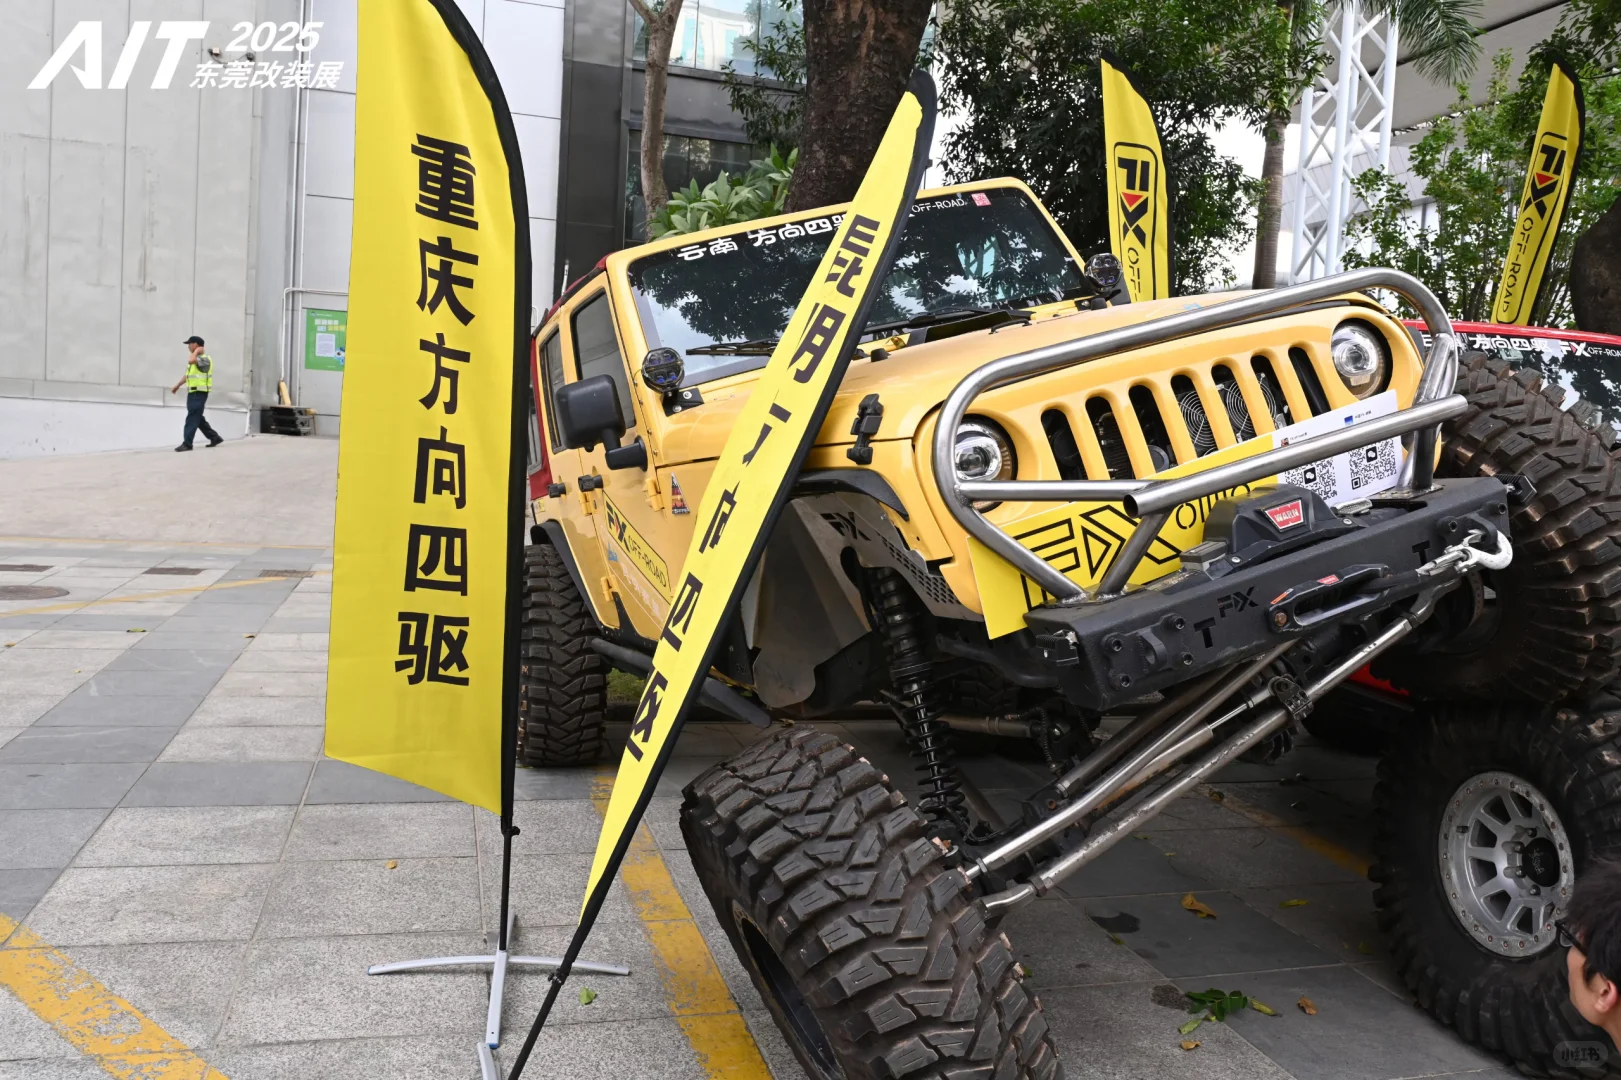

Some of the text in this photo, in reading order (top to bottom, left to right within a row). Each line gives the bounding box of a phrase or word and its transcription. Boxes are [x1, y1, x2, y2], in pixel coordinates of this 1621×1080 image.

[911, 198, 965, 213] OFF-ROAD
[677, 237, 739, 262] 云南
[1502, 217, 1534, 313] OFF-ROAD
[395, 133, 479, 686] 重庆方向四驱
[1273, 508, 1300, 522] WARN
